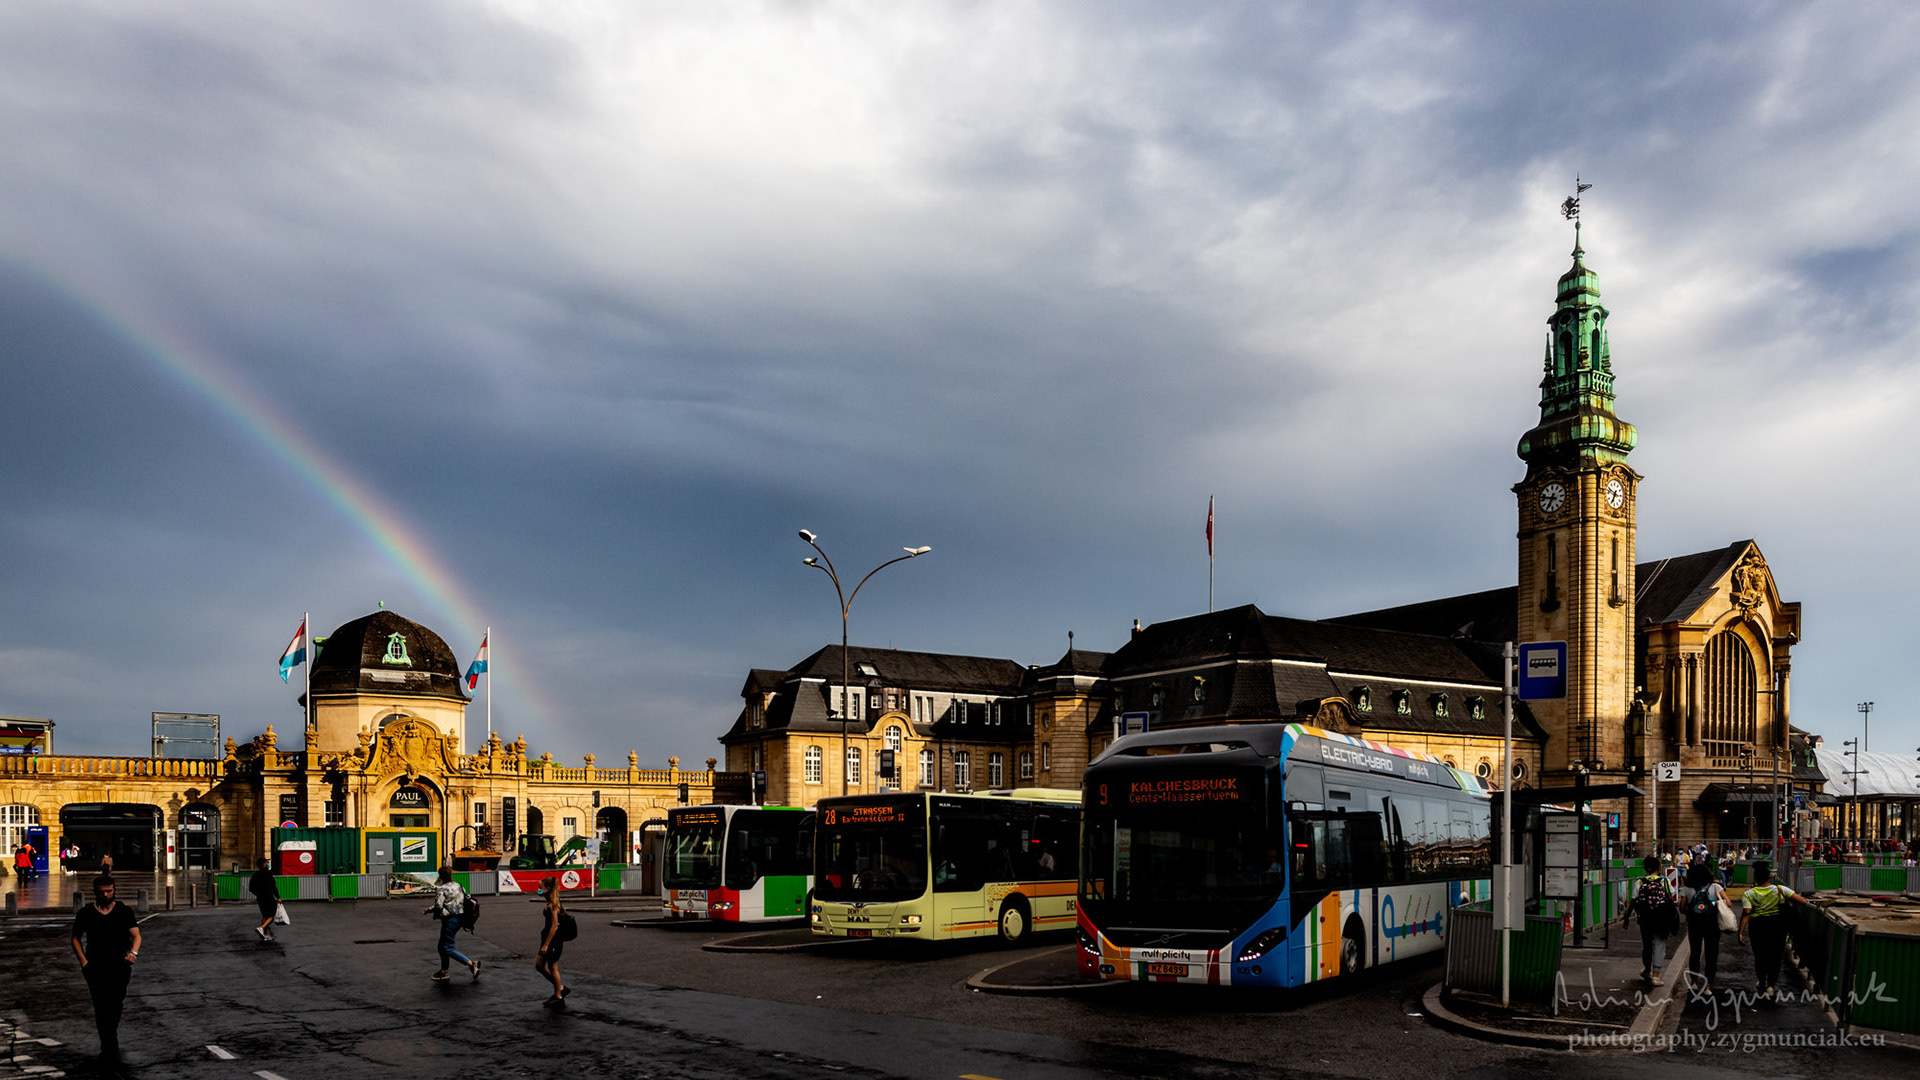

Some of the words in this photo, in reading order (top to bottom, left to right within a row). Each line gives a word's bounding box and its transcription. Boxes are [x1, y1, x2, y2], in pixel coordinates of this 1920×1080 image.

[1665, 769, 1674, 779] 2
[1131, 778, 1237, 793] KALCHESBRUCK
[396, 792, 422, 801] PAUL
[1099, 783, 1108, 805] 9
[853, 806, 893, 816] STRASSEN
[825, 809, 836, 825] 28
[1141, 950, 1191, 960] multiplicity
